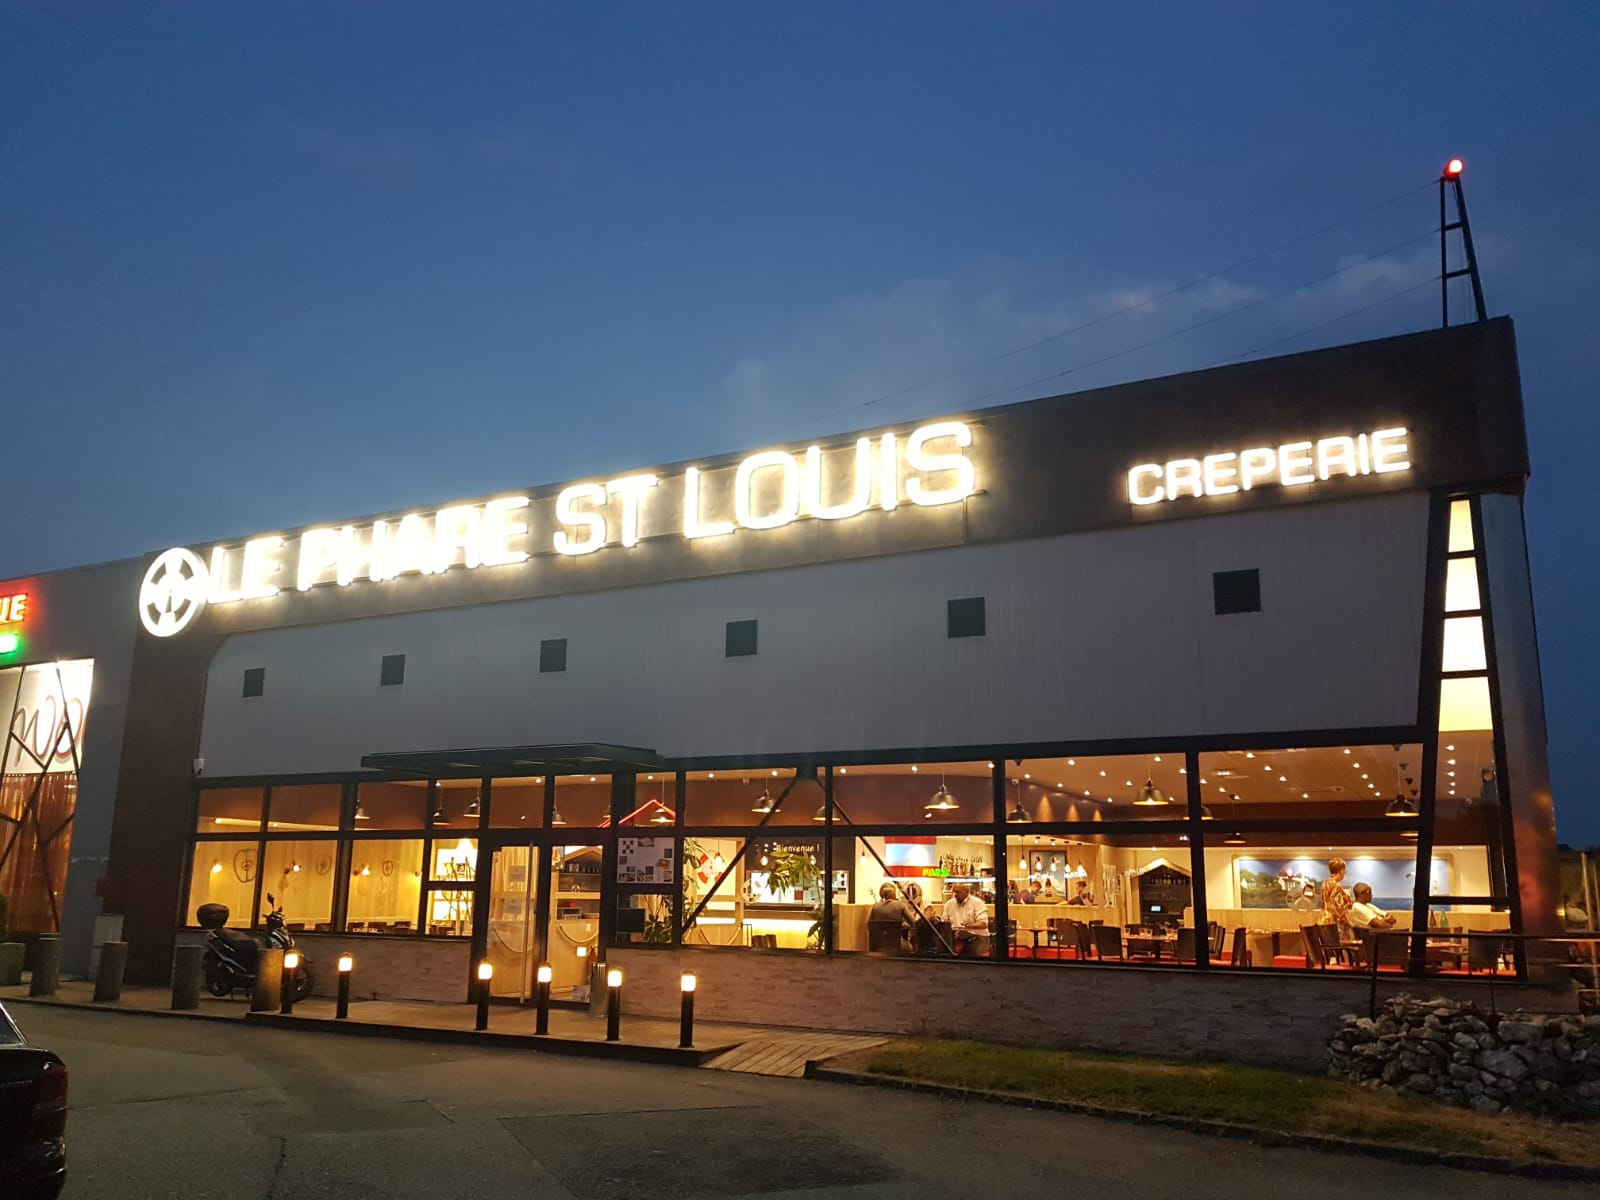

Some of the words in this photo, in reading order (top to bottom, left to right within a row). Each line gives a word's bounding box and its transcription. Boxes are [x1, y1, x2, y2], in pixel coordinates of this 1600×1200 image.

[208, 536, 284, 604] LE
[298, 496, 530, 591] PHARE
[553, 474, 659, 556] ST
[683, 421, 975, 539] LOUIS
[1128, 427, 1410, 505] CREPERIE
